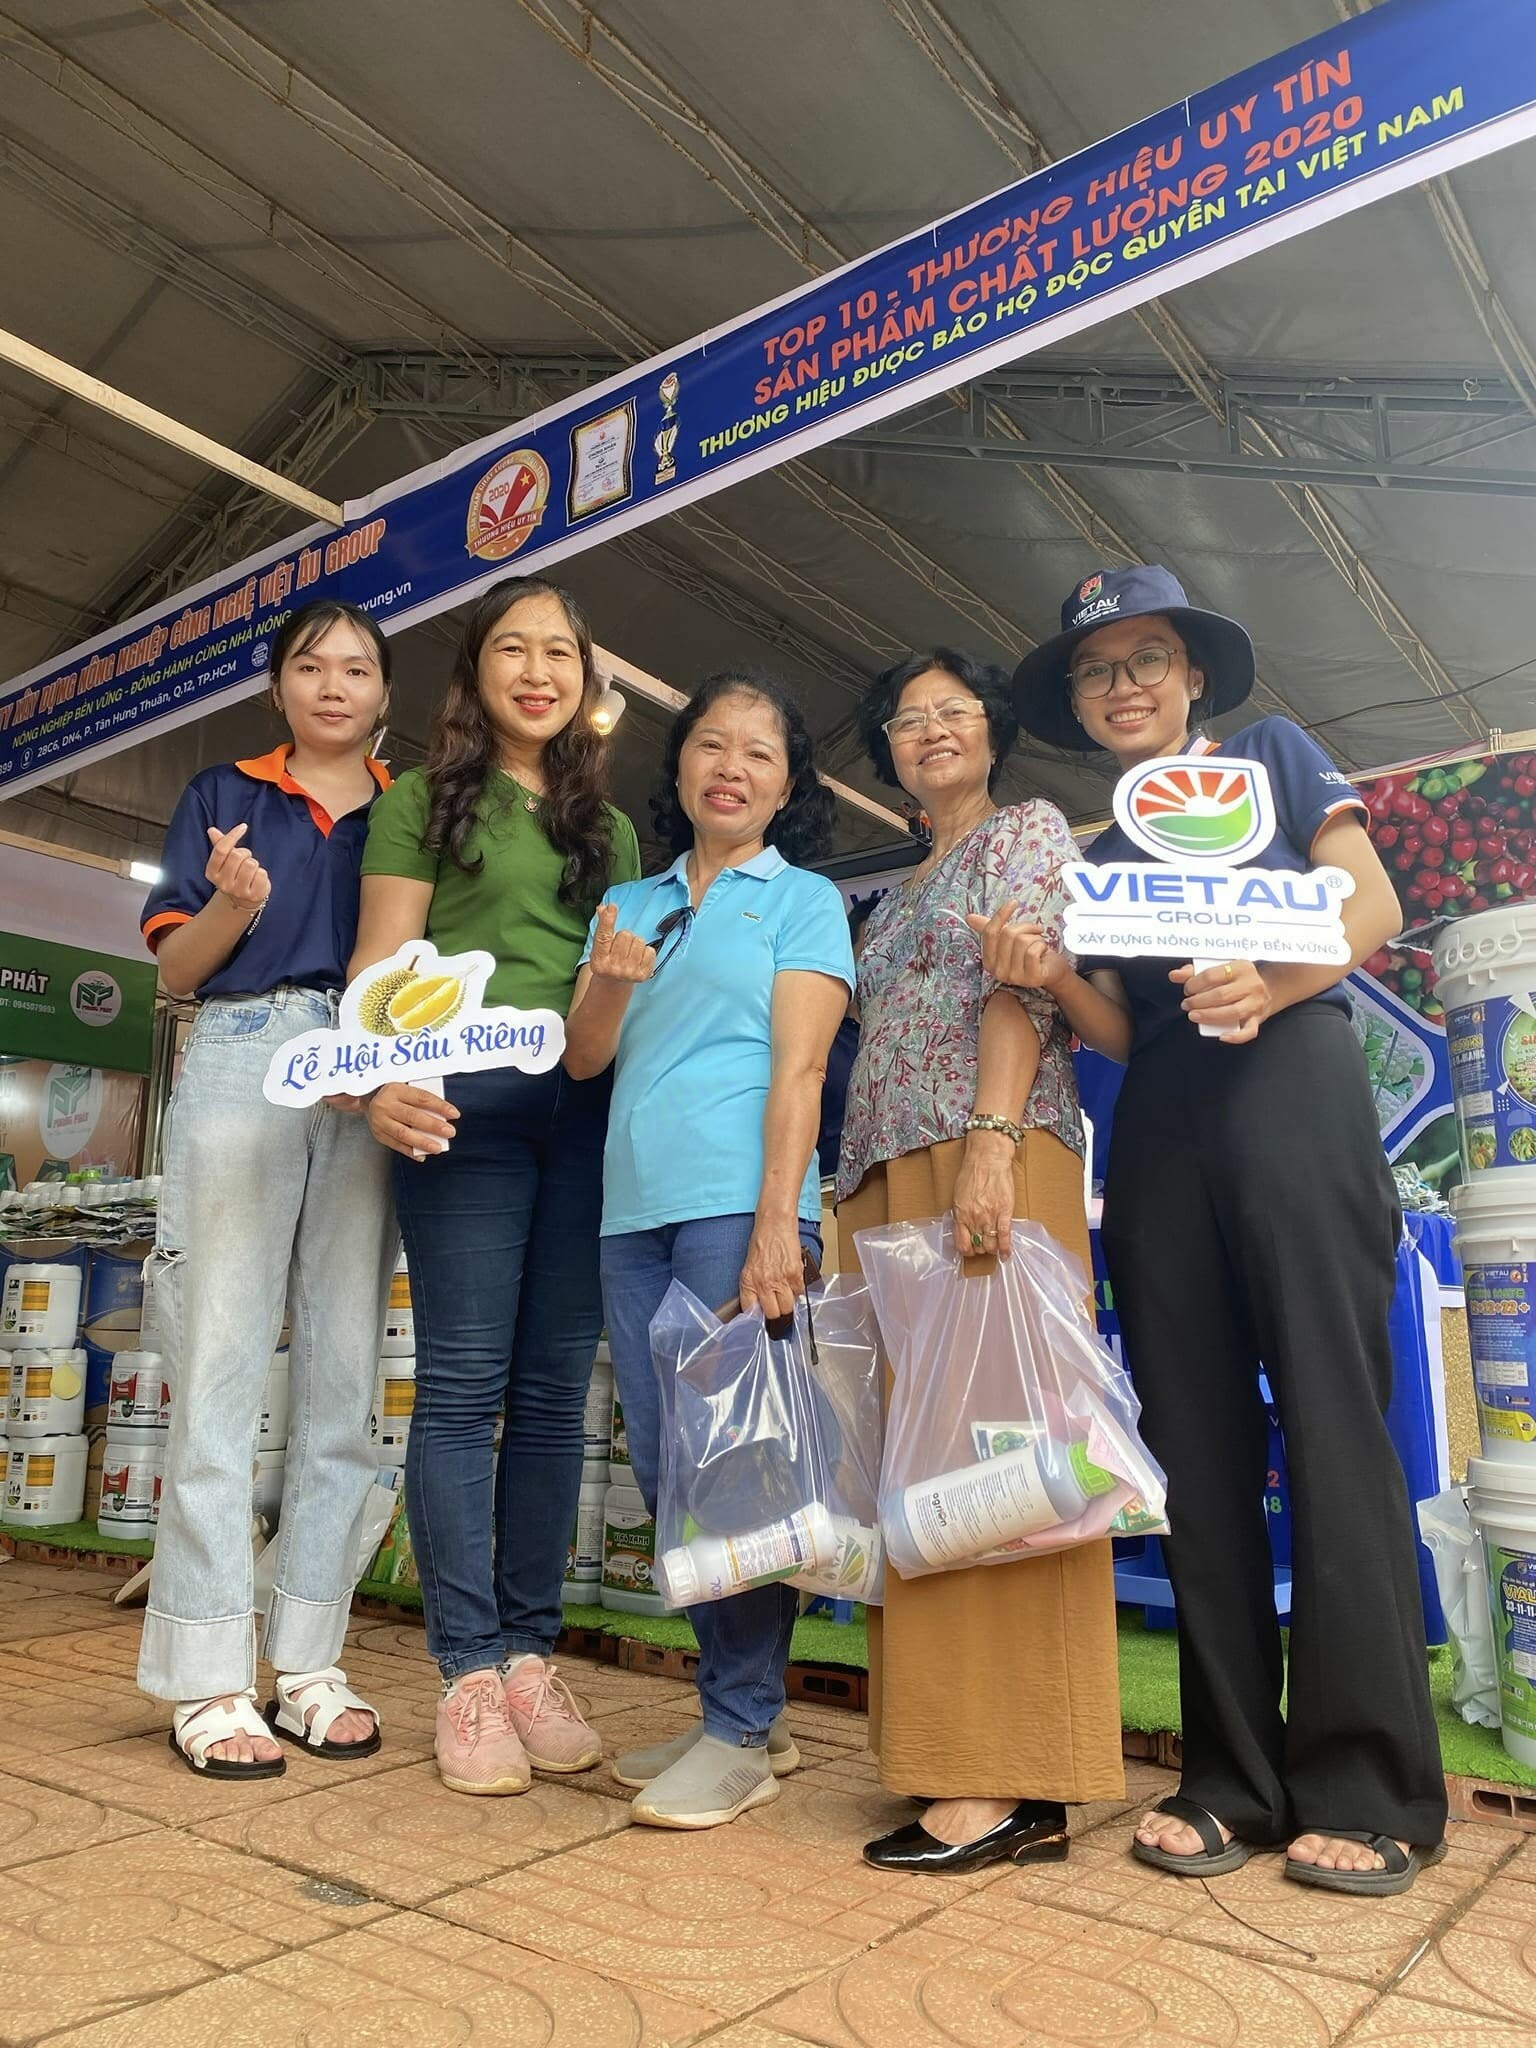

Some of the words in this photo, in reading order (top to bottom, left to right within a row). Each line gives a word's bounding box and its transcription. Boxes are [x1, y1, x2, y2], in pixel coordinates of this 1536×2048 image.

[764, 315, 826, 365] TOP
[839, 290, 877, 329] 10
[908, 195, 1073, 293] THƯƠNG
[1087, 135, 1183, 204] HIỆU
[1200, 94, 1258, 150] UY
[1273, 49, 1352, 115] TÍN
[699, 404, 790, 458] THƯƠNG
[795, 378, 846, 416] HIỆU
[852, 343, 924, 388] ĐƯỢC
[932, 311, 987, 352] BẢO
[995, 284, 1037, 322] HỘ
[1046, 252, 1113, 298] ĐỘC
[1122, 196, 1226, 260] QUYỀN
[1235, 168, 1286, 208] TẠI
[1296, 131, 1367, 179] VIỆT
[1378, 86, 1464, 145] NAM
[754, 351, 820, 406] SẢN
[831, 299, 935, 370] PHẨM
[948, 233, 1058, 314] CHẤT
[1072, 168, 1229, 258] LƯỢNG
[1244, 96, 1363, 176] 2020
[488, 482, 510, 503] 2020
[169, 605, 211, 651] CÔNG
[212, 576, 257, 630] NGHỆ
[259, 561, 295, 608] VIỆT
[296, 545, 321, 591] ÂU
[325, 518, 386, 576] GROUP
[197, 660, 237, 686] TP.HCM
[1078, 933, 1106, 945] XÂY
[1110, 934, 1152, 947] DỰNG
[1157, 932, 1199, 947] NÔNG
[1205, 936, 1258, 951] NGHIỆP
[1157, 911, 1251, 926] GROUP
[0, 970, 48, 994] PHÁT
[281, 1046, 320, 1090] Lễ
[329, 1042, 383, 1078] Hội
[390, 1028, 454, 1066] Sầu
[460, 1022, 545, 1057] Riêng
